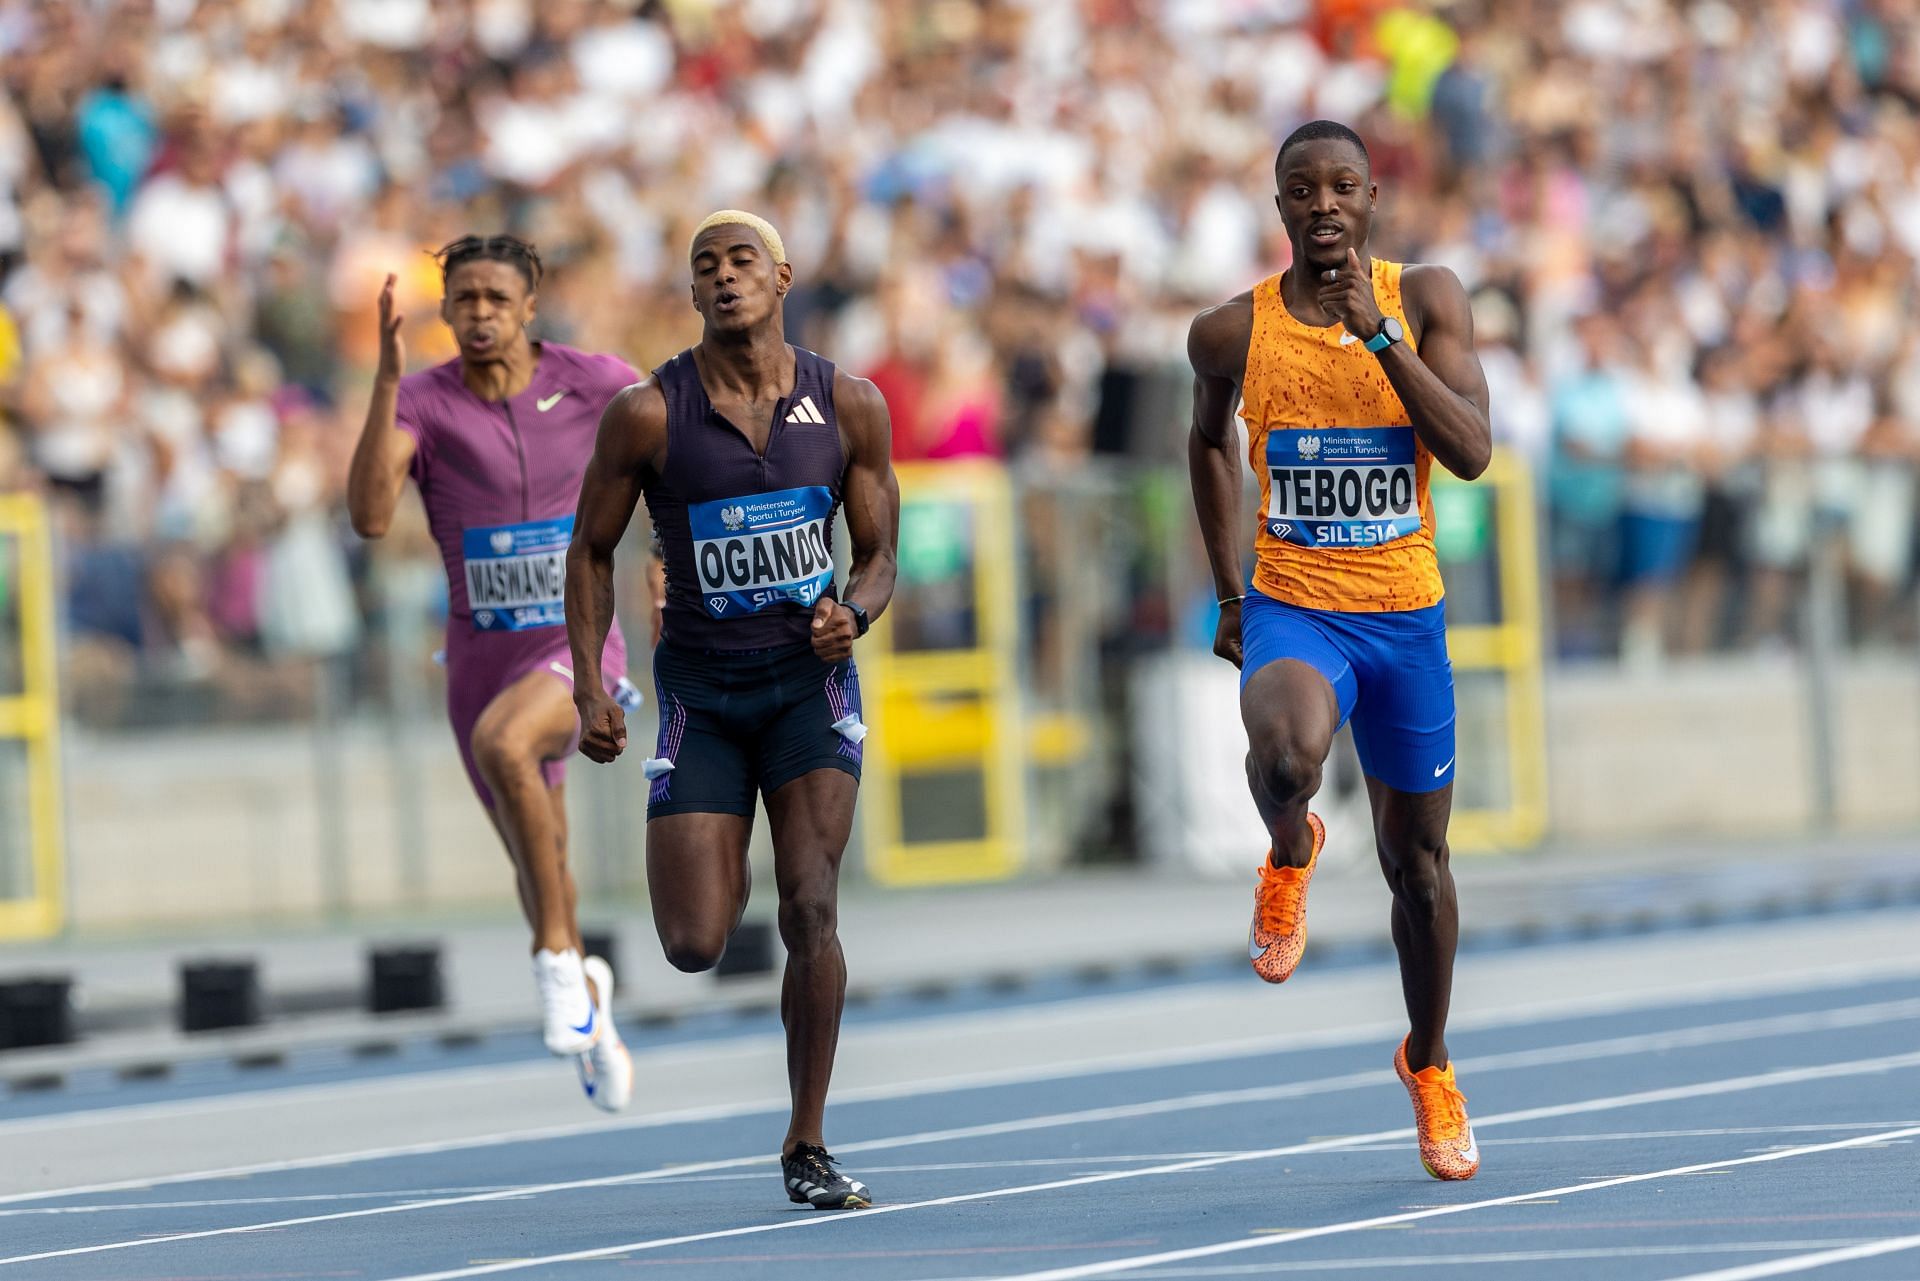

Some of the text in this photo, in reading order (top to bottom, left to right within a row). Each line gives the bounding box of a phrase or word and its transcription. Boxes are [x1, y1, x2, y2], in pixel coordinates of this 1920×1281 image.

[1323, 436, 1373, 445] Ministerstwo
[1323, 445, 1349, 455] Sportu
[1353, 445, 1389, 455] Turystyki
[1271, 467, 1412, 517] TEBOGO
[746, 499, 796, 513] Ministerstwo
[747, 512, 773, 524] Sportu
[1316, 525, 1400, 543] SILESIA
[700, 522, 829, 589] OGANDO
[752, 580, 822, 608] SILESIA
